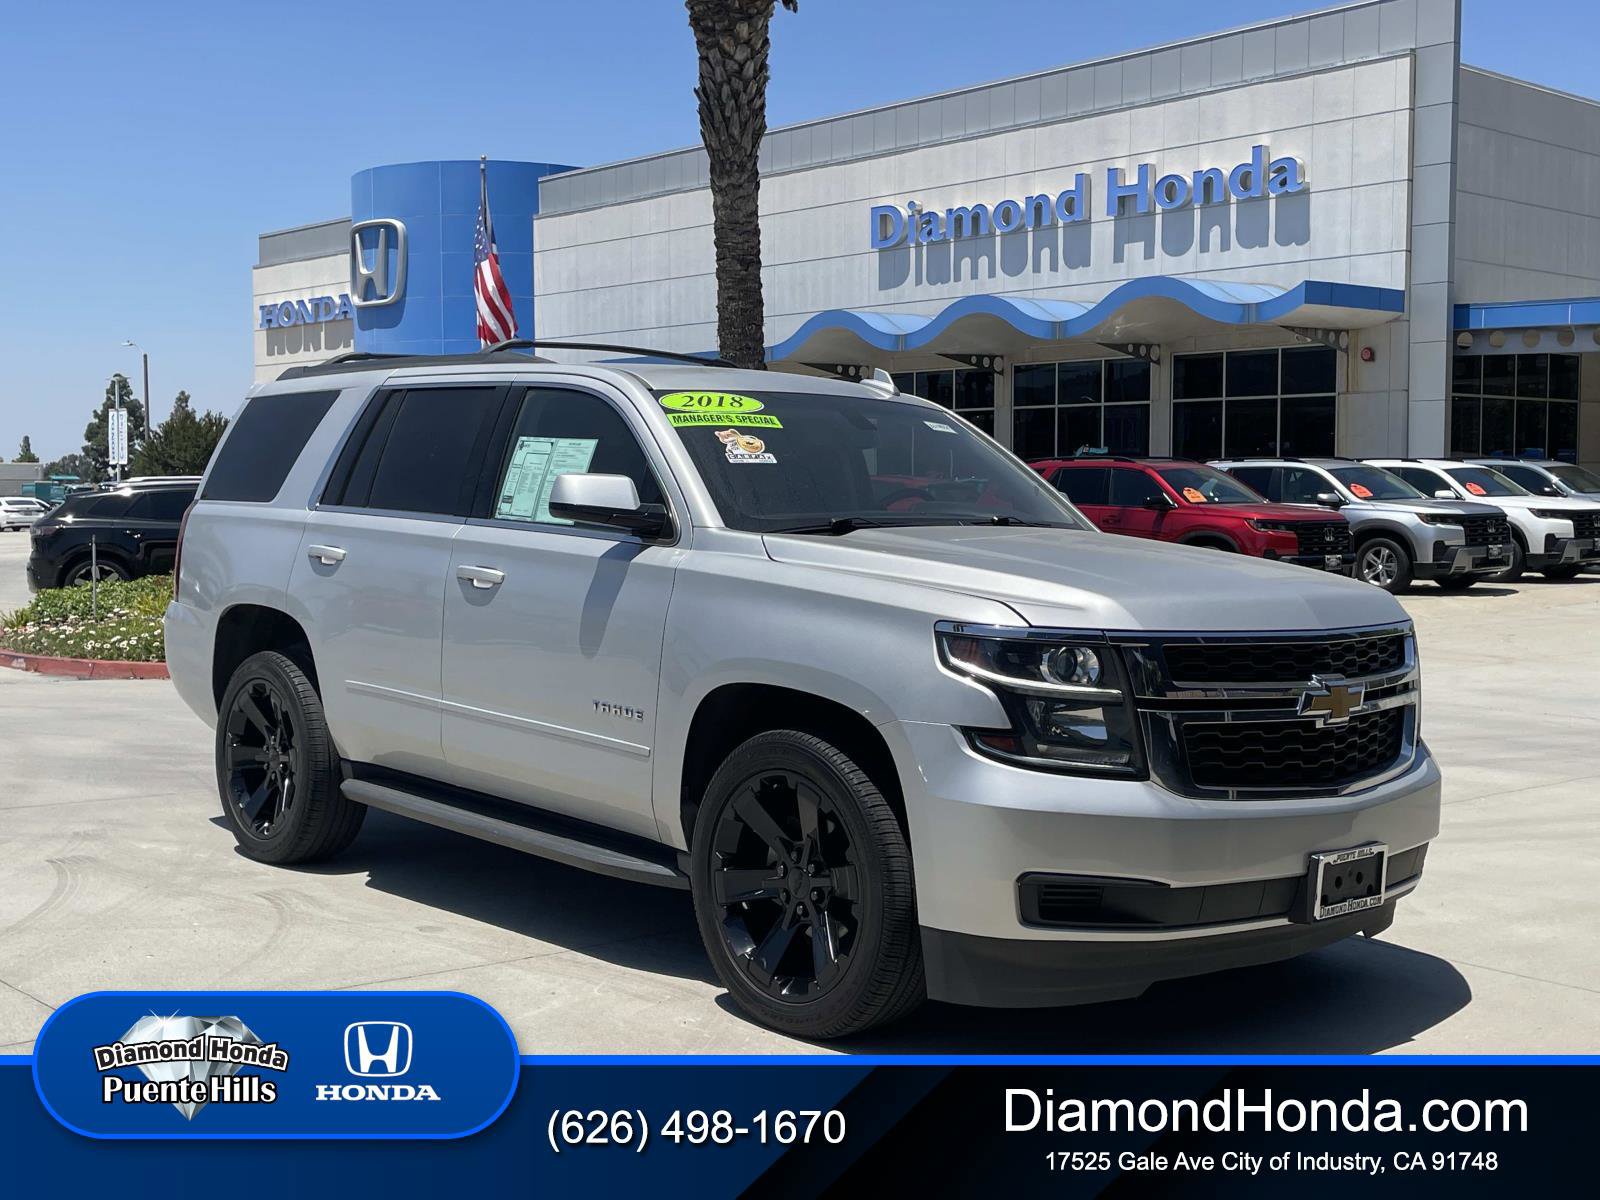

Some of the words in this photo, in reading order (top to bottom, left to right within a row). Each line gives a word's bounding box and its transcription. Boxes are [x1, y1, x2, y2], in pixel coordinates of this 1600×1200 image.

[870, 172, 1092, 250] Diamond
[1106, 144, 1306, 217] Honda
[259, 293, 354, 329] HONDA
[681, 395, 744, 408] 2018
[672, 414, 734, 424] MANAGER'S
[737, 415, 777, 425] SPECIAL
